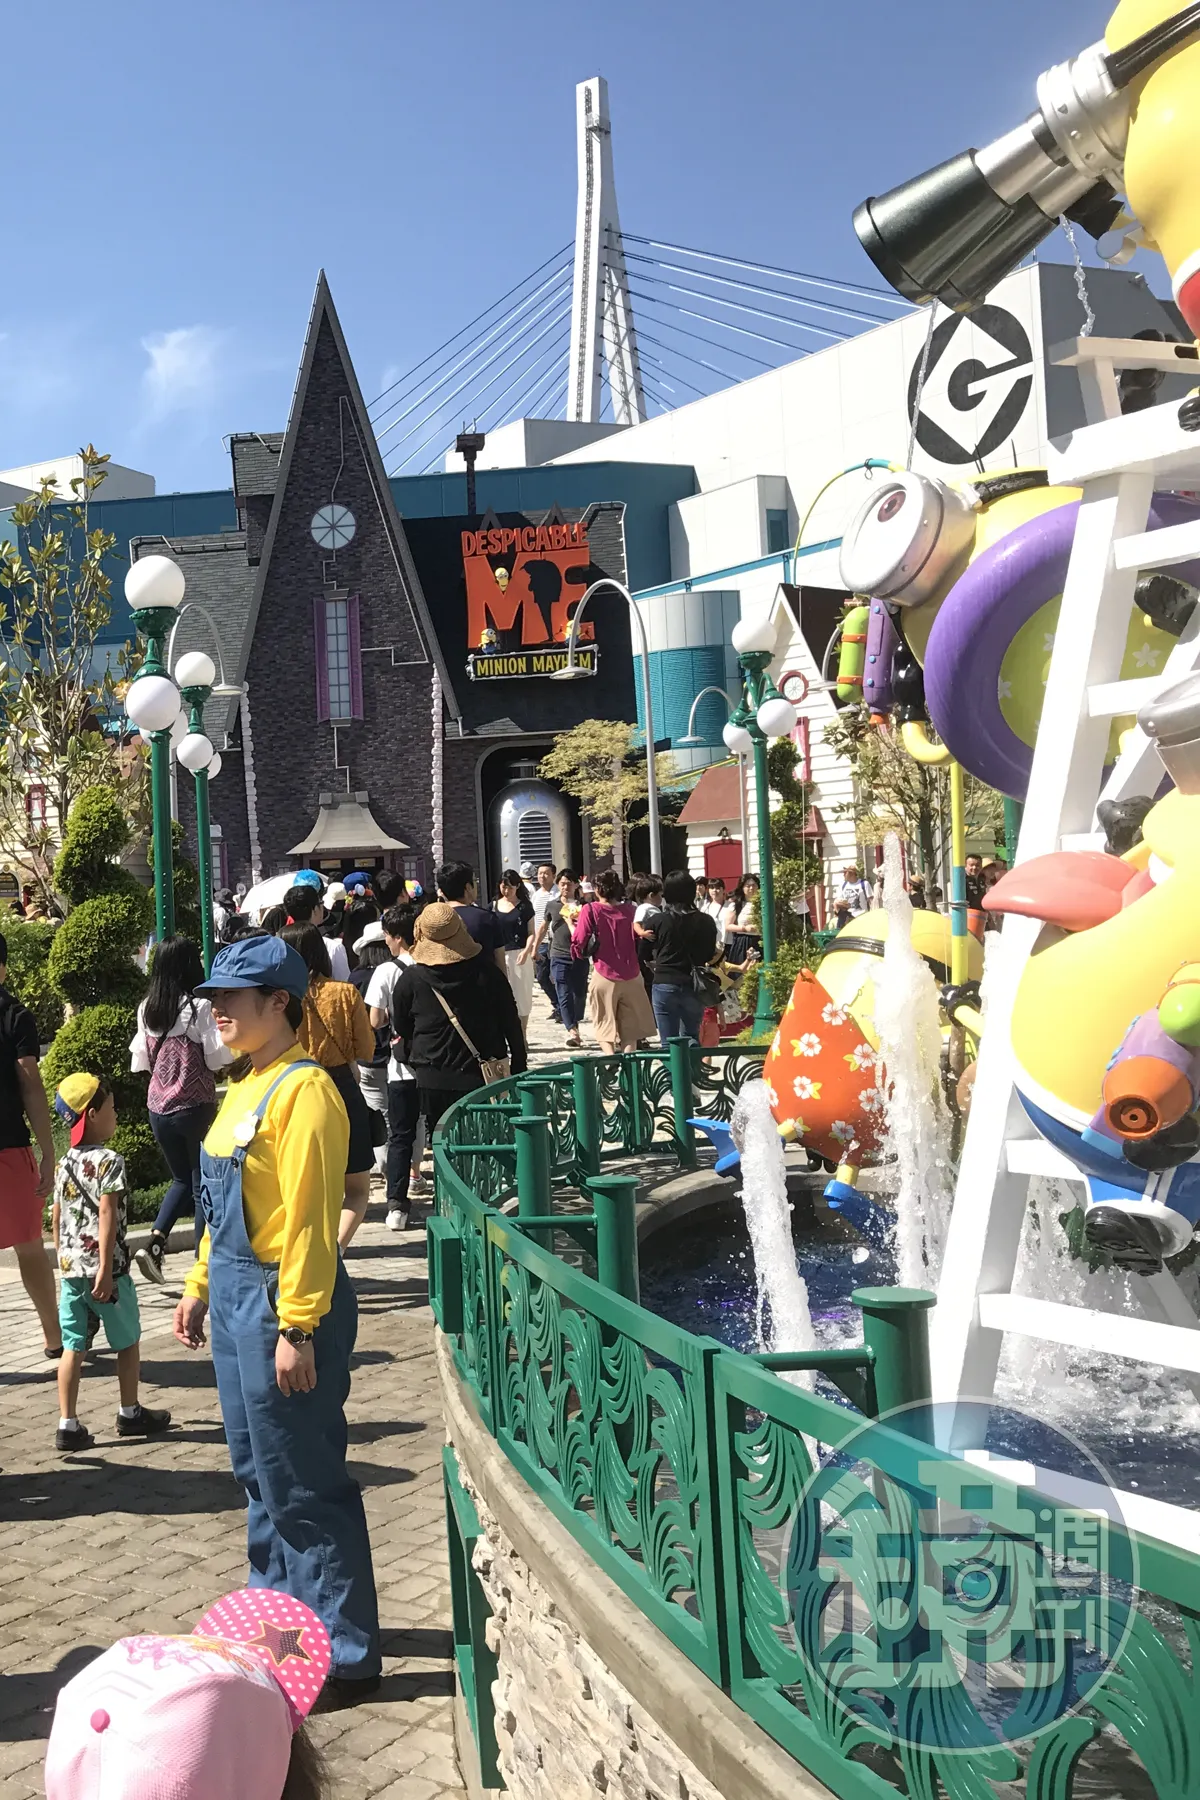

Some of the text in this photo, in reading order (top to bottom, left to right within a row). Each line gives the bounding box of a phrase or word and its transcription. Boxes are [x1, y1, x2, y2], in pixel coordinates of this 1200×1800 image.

[461, 522, 589, 557] DESPICABLE
[463, 547, 595, 649] ME
[476, 656, 527, 676] MINION
